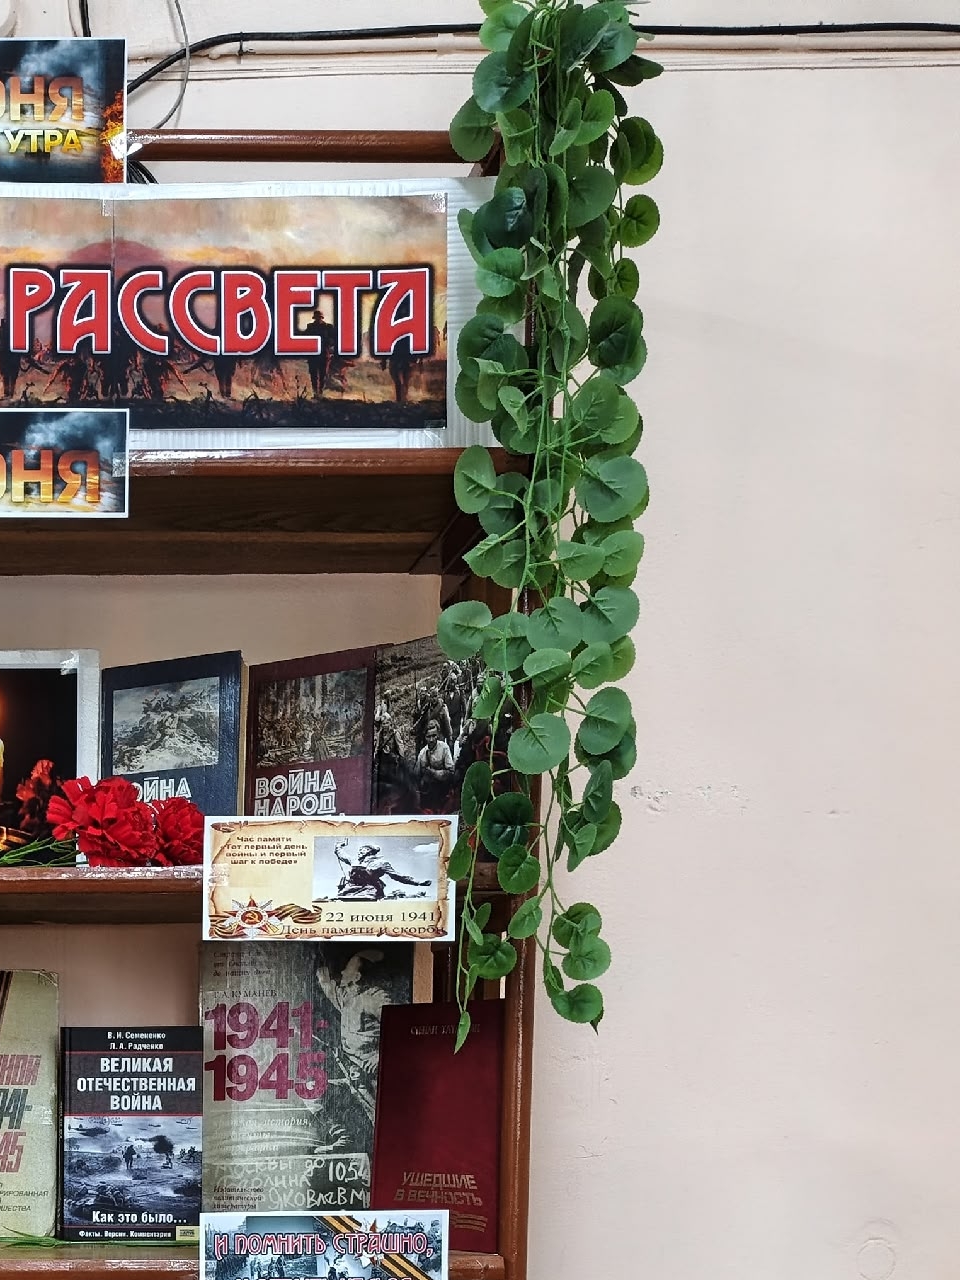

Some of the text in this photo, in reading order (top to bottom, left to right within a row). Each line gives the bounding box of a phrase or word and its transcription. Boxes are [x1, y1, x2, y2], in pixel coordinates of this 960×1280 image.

[3, 129, 83, 153] УТРА
[8, 265, 431, 356] РАССВЕТА
[256, 769, 336, 799] ВОЙНА
[255, 794, 336, 815] НАРОД
[326, 913, 435, 922] 22 июня 1941
[101, 1058, 173, 1072] ВЕЛИКАЯ
[77, 1078, 196, 1092] ОТЕЧЕСТВЕННАЯ
[205, 1054, 328, 1101] 1945
[110, 1093, 162, 1110] ВОЙНА
[93, 1211, 187, 1224] Как это было...
